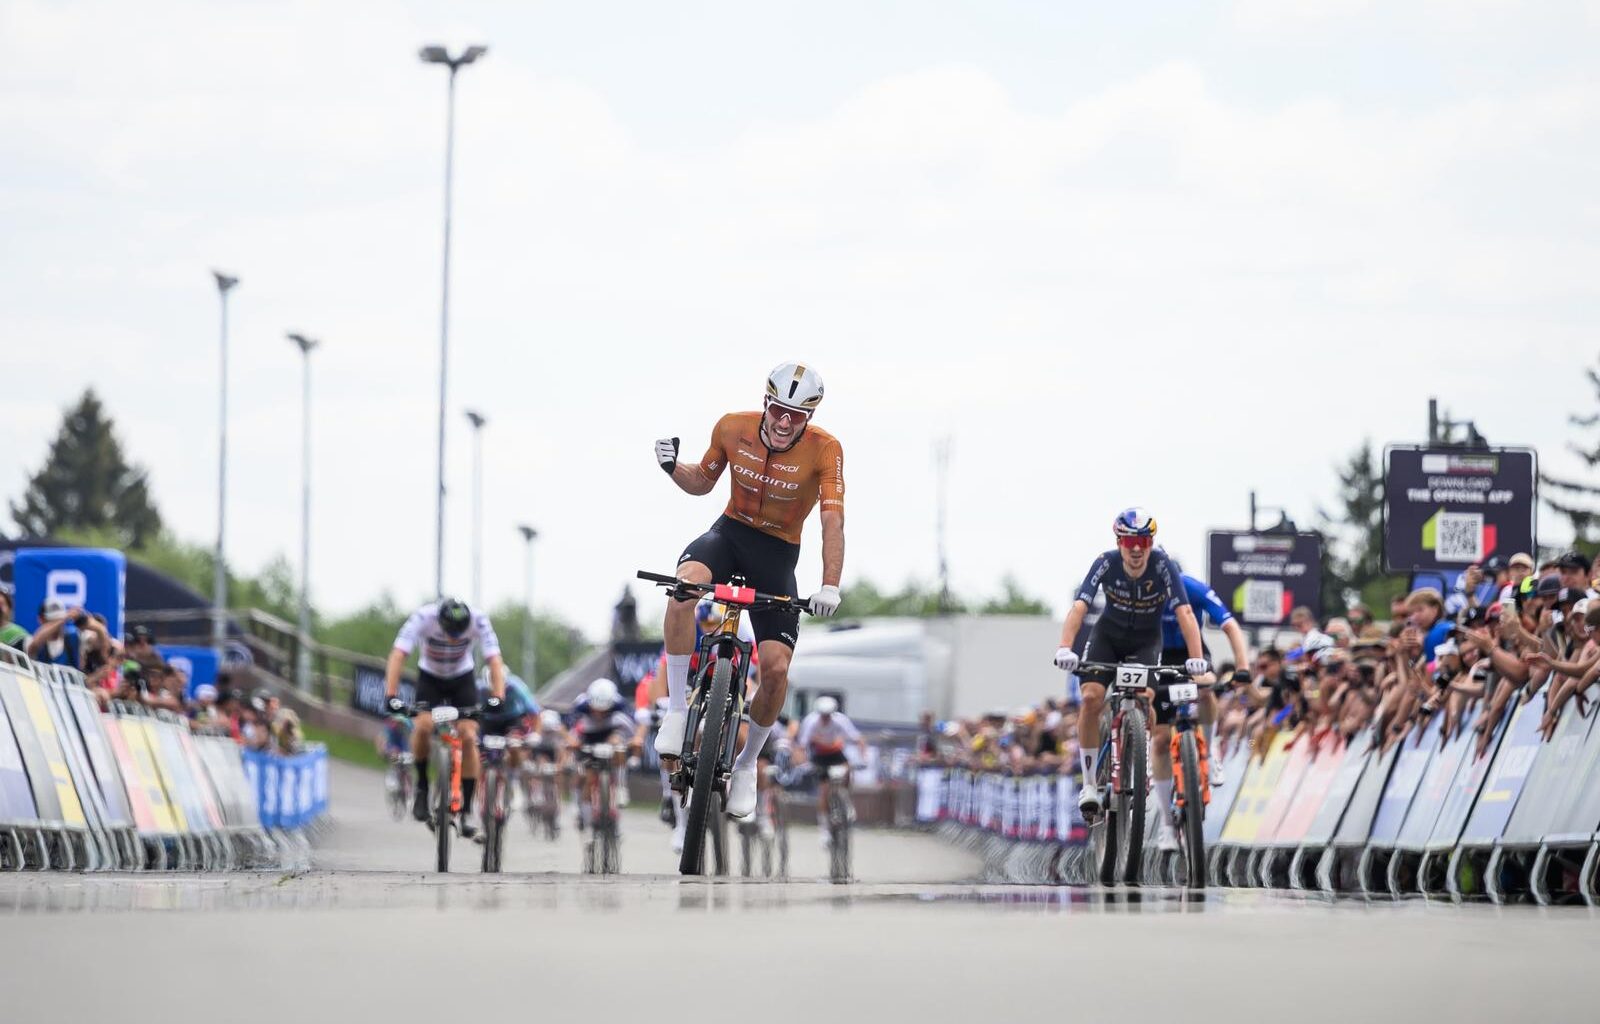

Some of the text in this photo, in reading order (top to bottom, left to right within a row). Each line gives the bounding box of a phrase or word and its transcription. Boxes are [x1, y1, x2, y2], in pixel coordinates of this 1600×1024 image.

[1407, 488, 1514, 503] THE OFFICIAL APP
[731, 586, 739, 598] 1
[1122, 672, 1143, 684] 37
